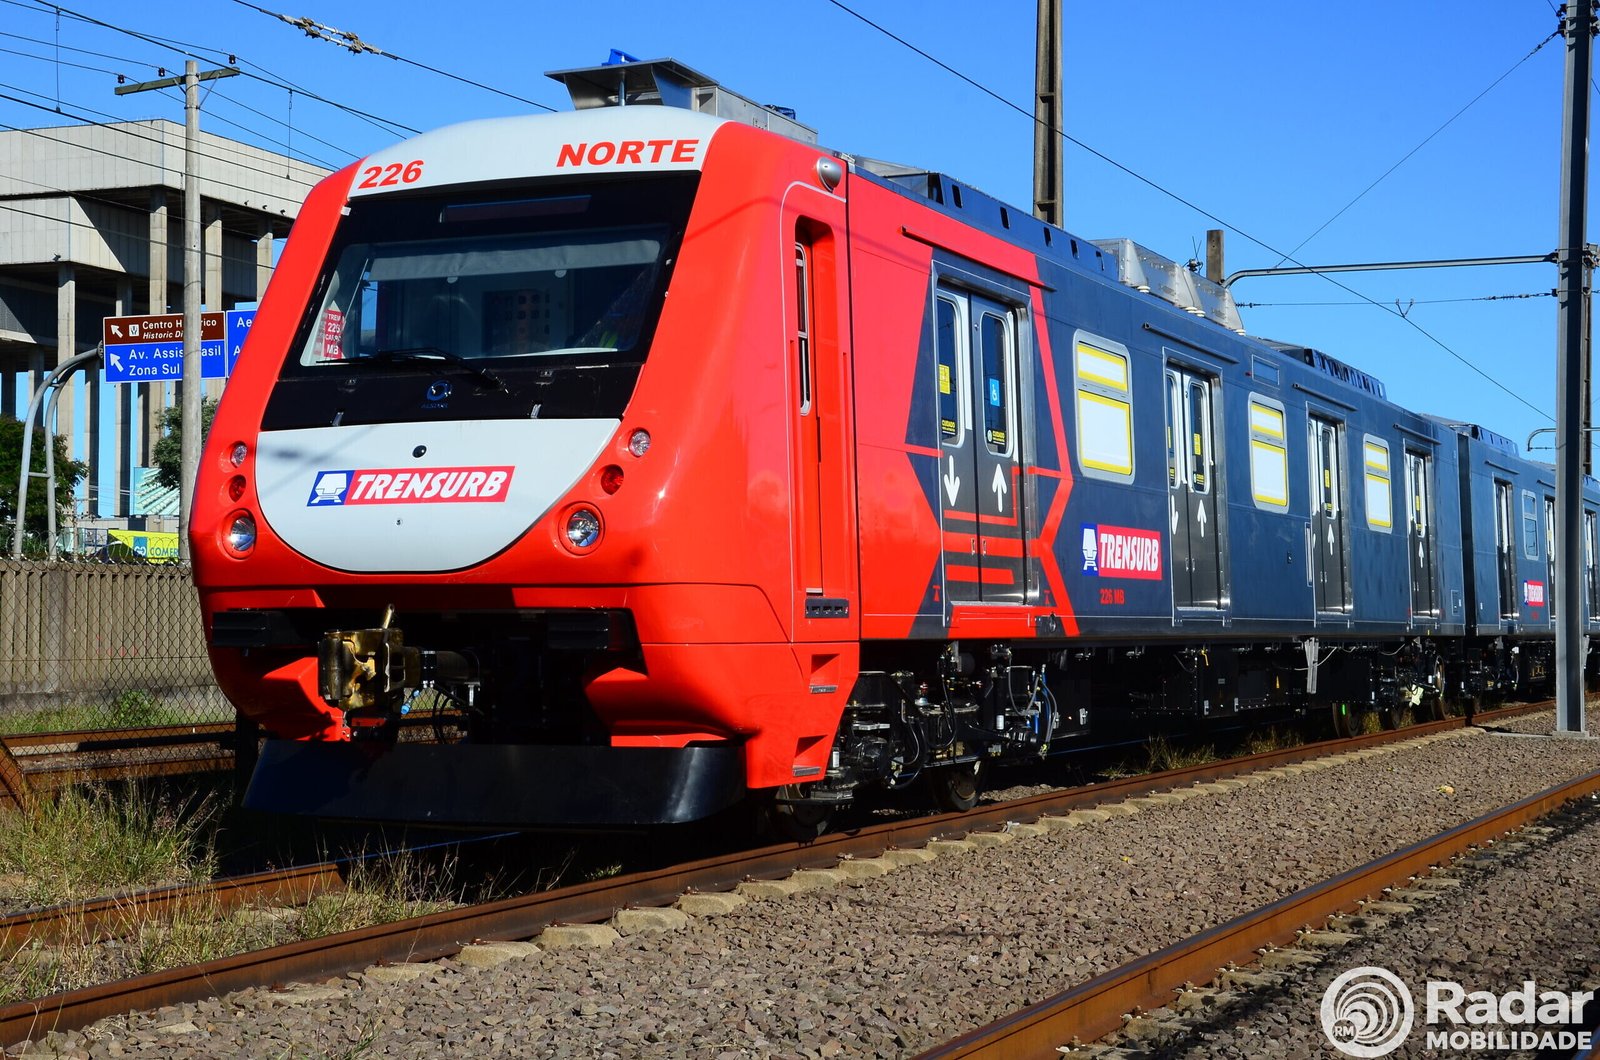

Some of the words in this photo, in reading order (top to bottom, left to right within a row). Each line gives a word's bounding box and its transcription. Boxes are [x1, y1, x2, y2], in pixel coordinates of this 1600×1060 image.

[556, 139, 699, 168] NORTE
[358, 159, 424, 189] 226
[142, 320, 173, 330] Centro
[143, 330, 173, 339] Historic
[129, 349, 148, 360] Av.
[153, 347, 183, 359] Assis
[129, 365, 158, 376] Zona
[162, 363, 180, 375] Sul
[351, 471, 508, 500] TRENSURB
[1100, 533, 1159, 572] TRENSURB
[1100, 588, 1113, 605] 226
[1113, 588, 1125, 605] MB
